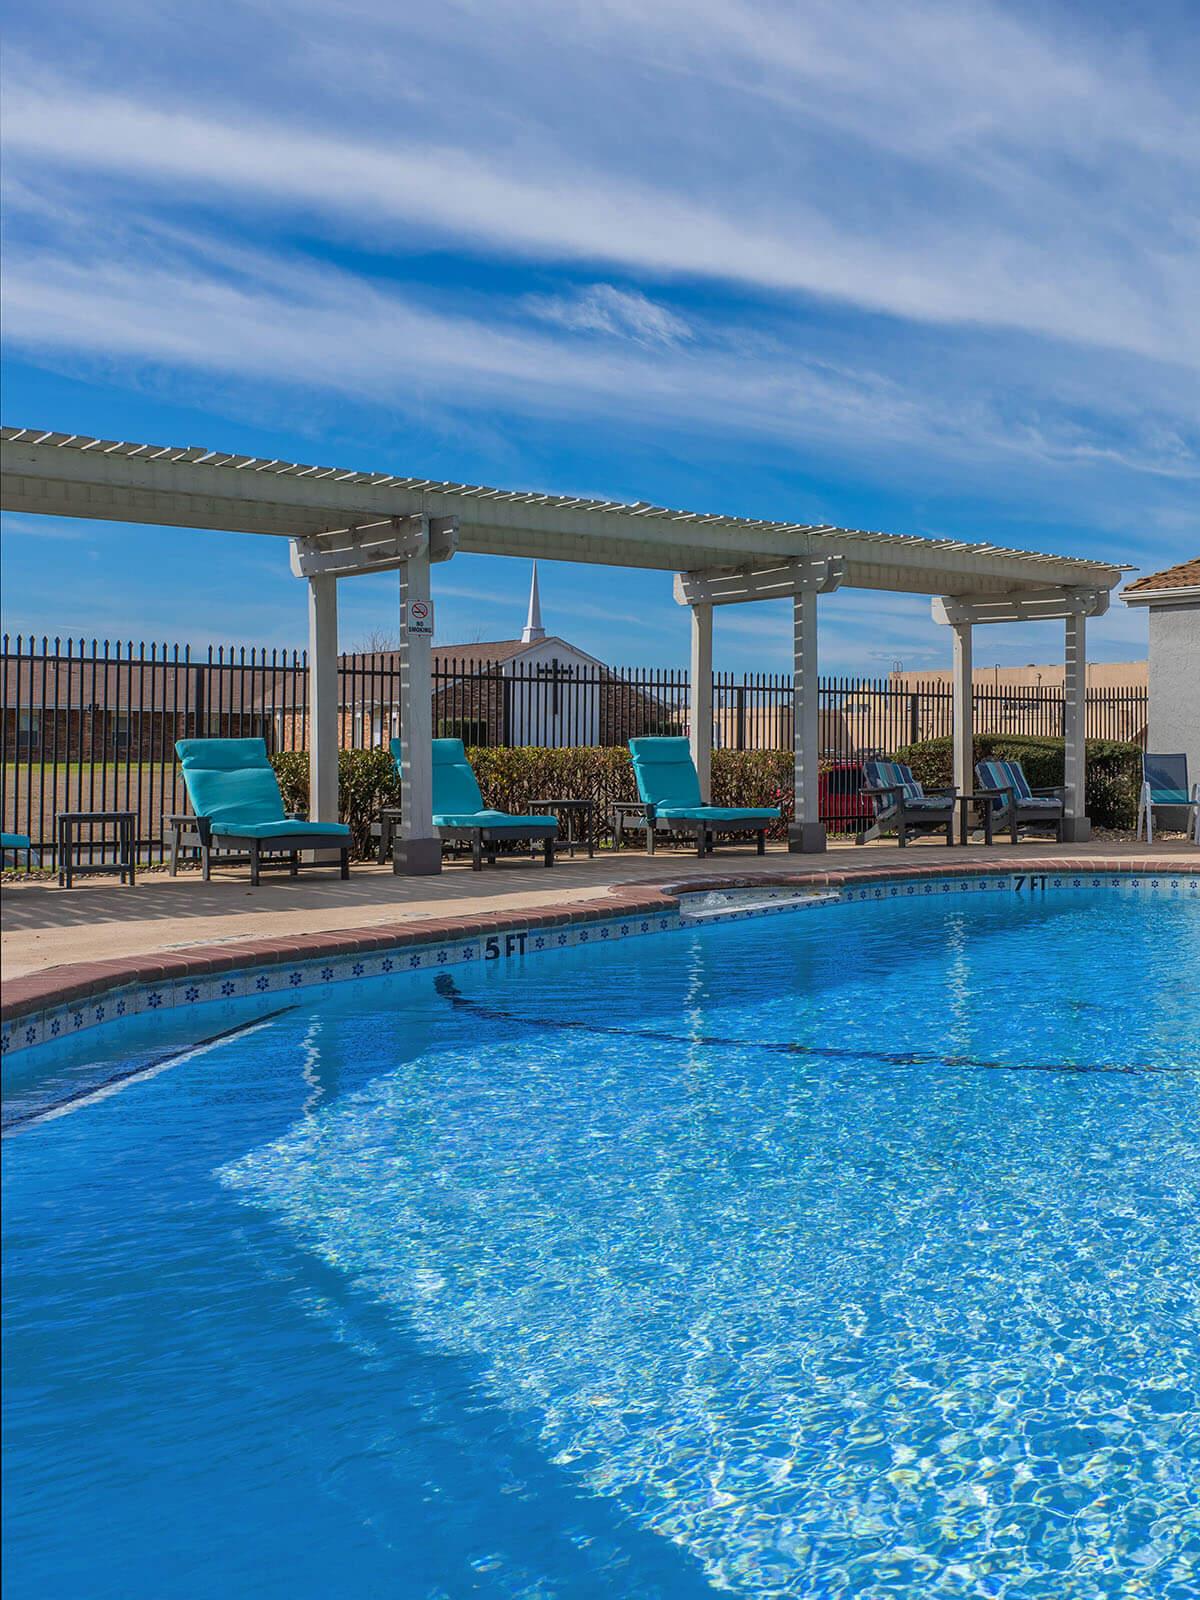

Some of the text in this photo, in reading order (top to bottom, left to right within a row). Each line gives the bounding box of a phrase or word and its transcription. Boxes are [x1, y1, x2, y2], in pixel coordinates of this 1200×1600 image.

[1014, 875, 1048, 891] 7 FT
[485, 933, 528, 960] 5 FT
